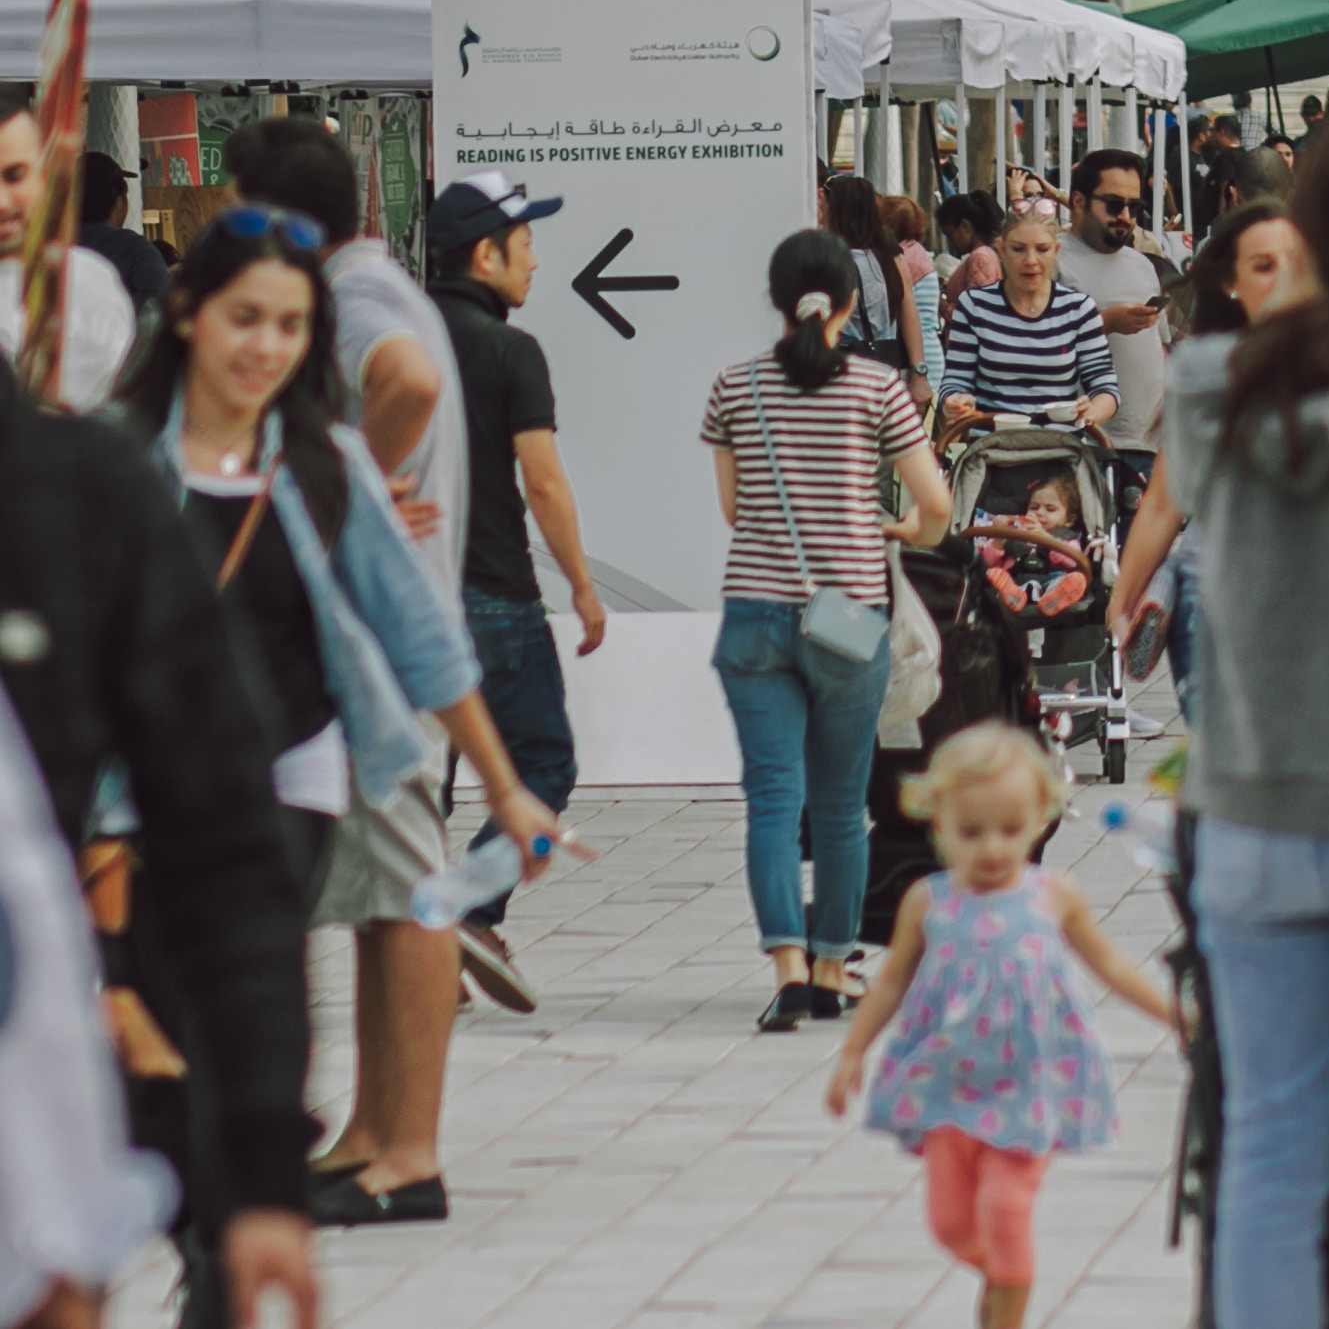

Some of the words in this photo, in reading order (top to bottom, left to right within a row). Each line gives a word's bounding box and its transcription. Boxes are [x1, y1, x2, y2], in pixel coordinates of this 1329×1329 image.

[456, 121, 560, 141] إيجابية
[565, 119, 626, 136] طاقة
[631, 118, 702, 139] القراءة
[706, 120, 783, 138] معرض
[456, 148, 526, 164] READING
[530, 147, 545, 162] IS
[549, 146, 621, 162] POSITIVE
[626, 145, 688, 160] ENERGY
[692, 143, 784, 159] EXHIBITION
